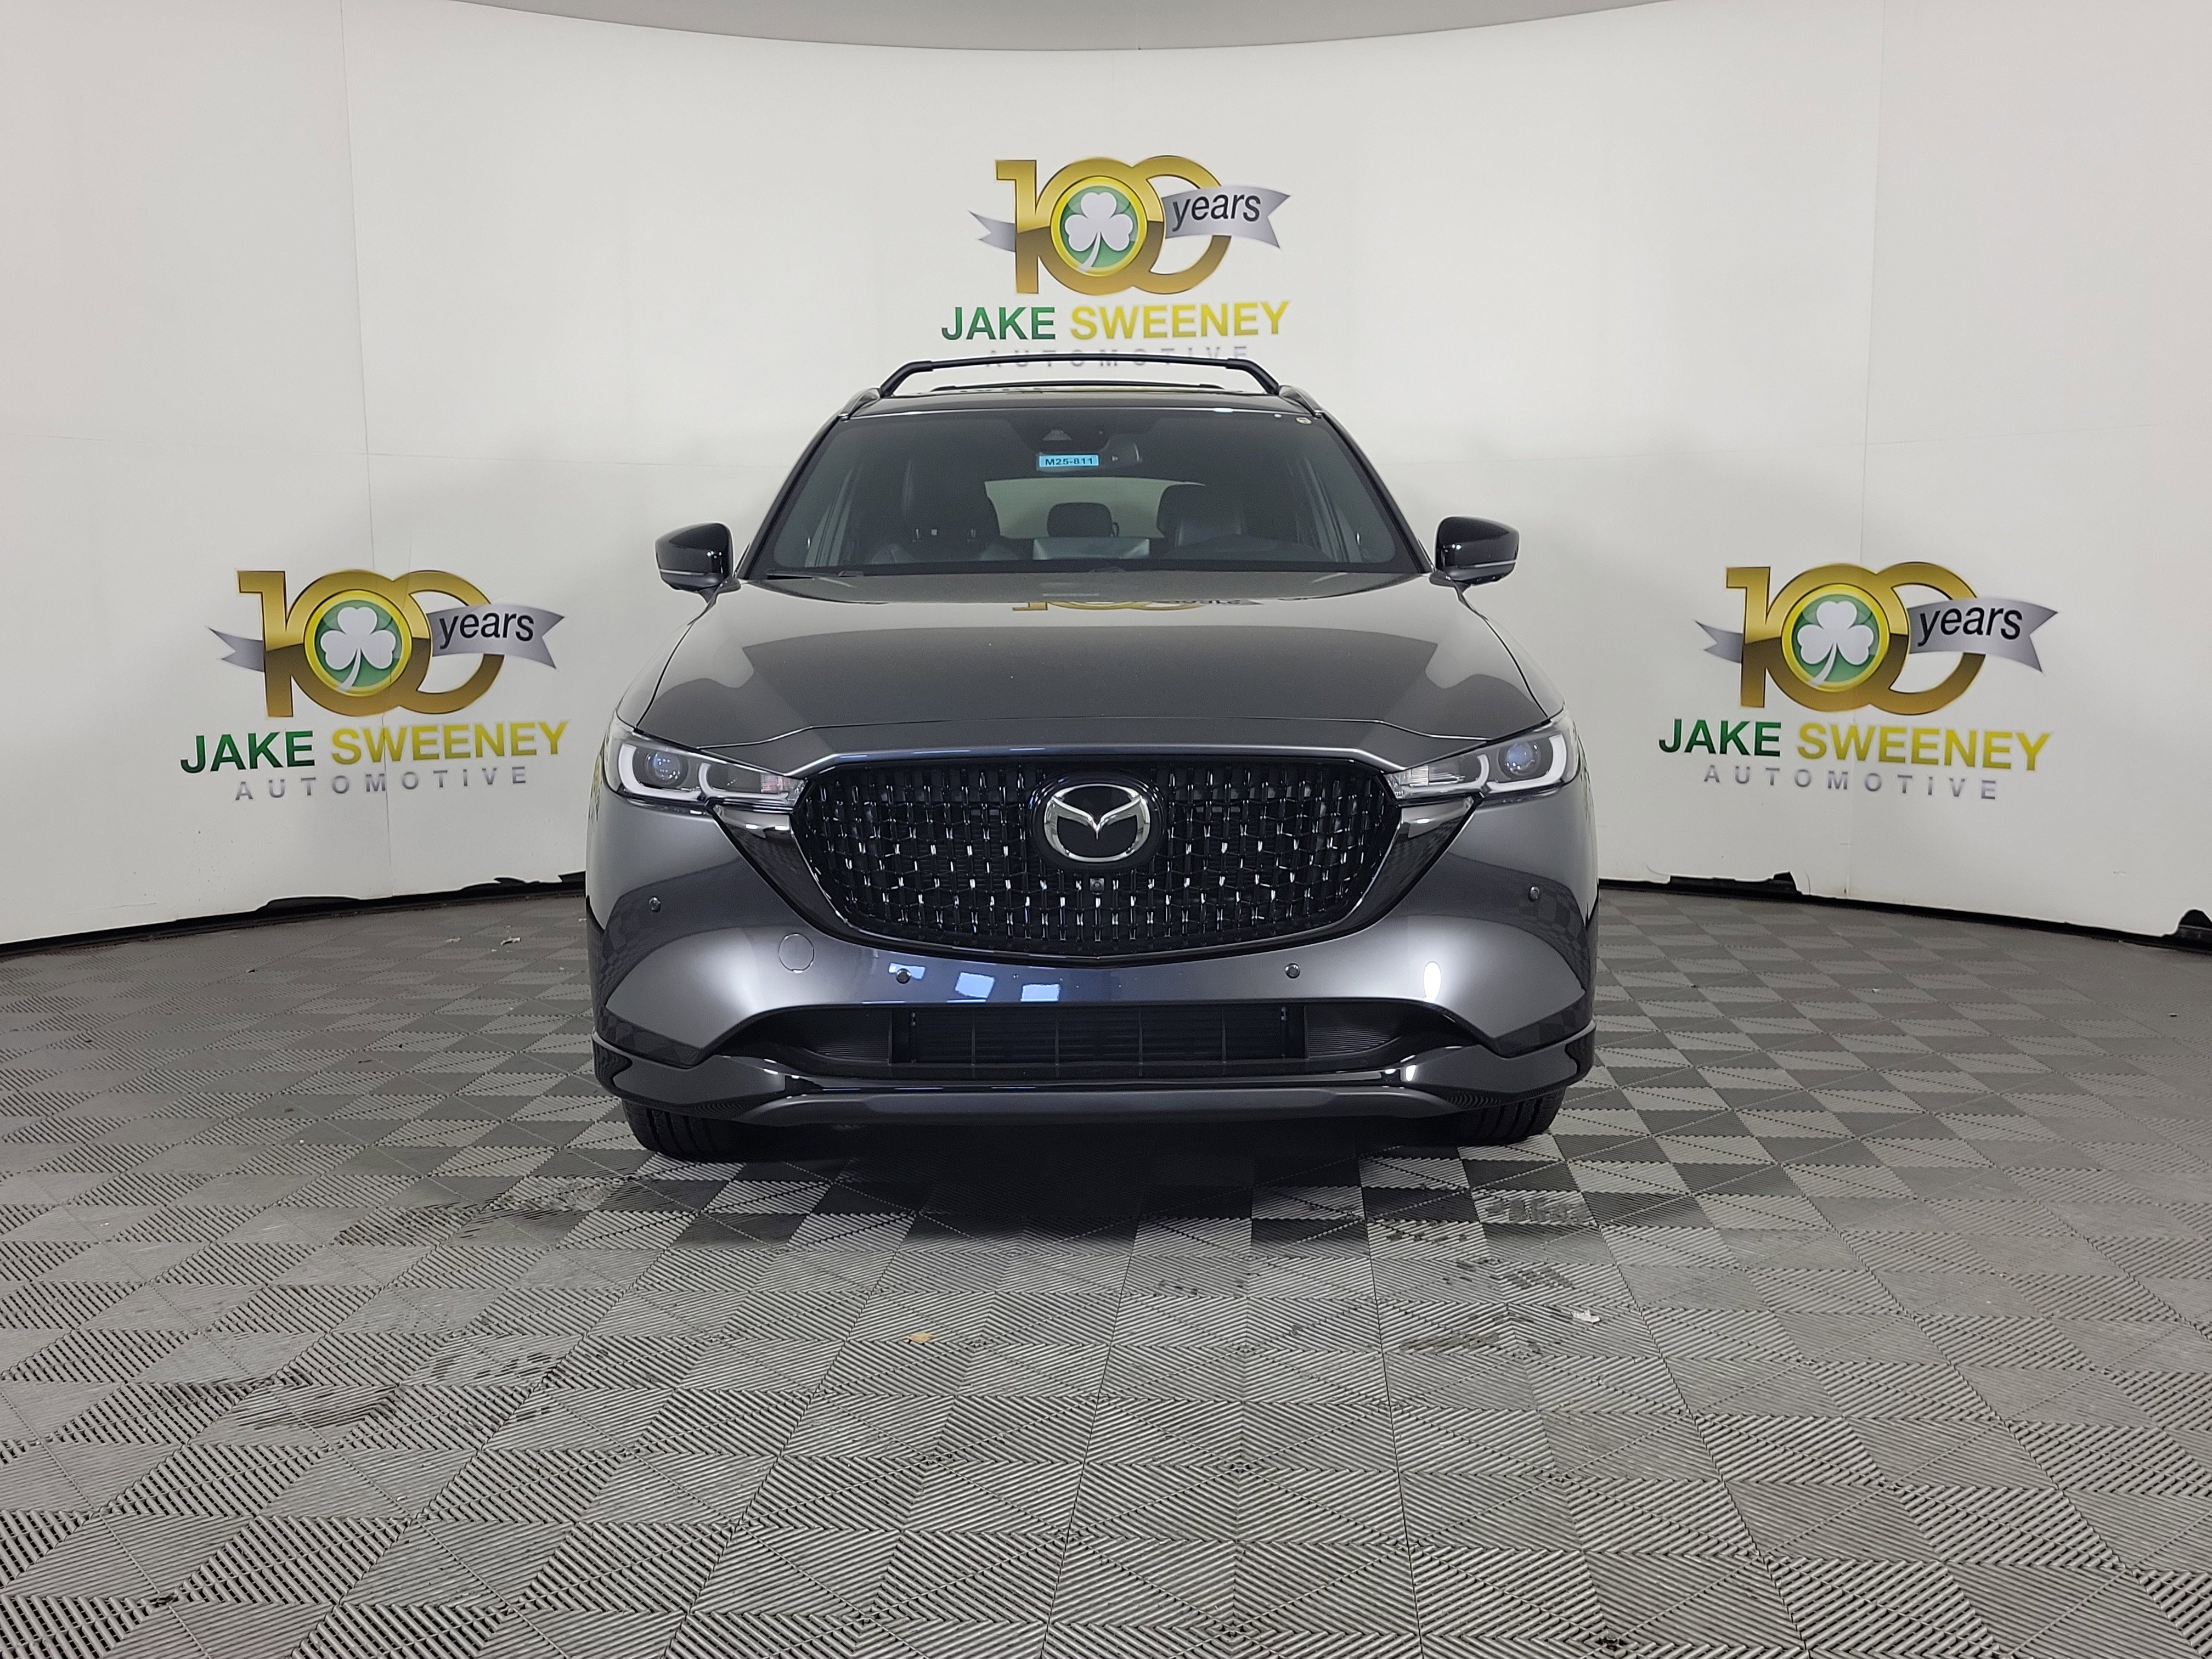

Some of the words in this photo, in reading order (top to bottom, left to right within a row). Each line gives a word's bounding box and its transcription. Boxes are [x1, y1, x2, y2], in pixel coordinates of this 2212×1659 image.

[1171, 192, 1262, 233] years
[940, 306, 1056, 341] JAKE
[1070, 300, 1290, 340] SWEENEY
[985, 346, 1249, 368] TTIVE
[1045, 457, 1093, 466] M25-811
[439, 612, 534, 649] years
[1917, 605, 2023, 647] years
[180, 730, 315, 774] JAKE
[331, 721, 568, 765] SWEENEY
[1658, 719, 1782, 757] JAKE
[1797, 723, 2051, 771] SWEENEY
[235, 766, 527, 802] AUTOMOTIVE
[1703, 765, 1997, 800] AUTOMOTIVE
